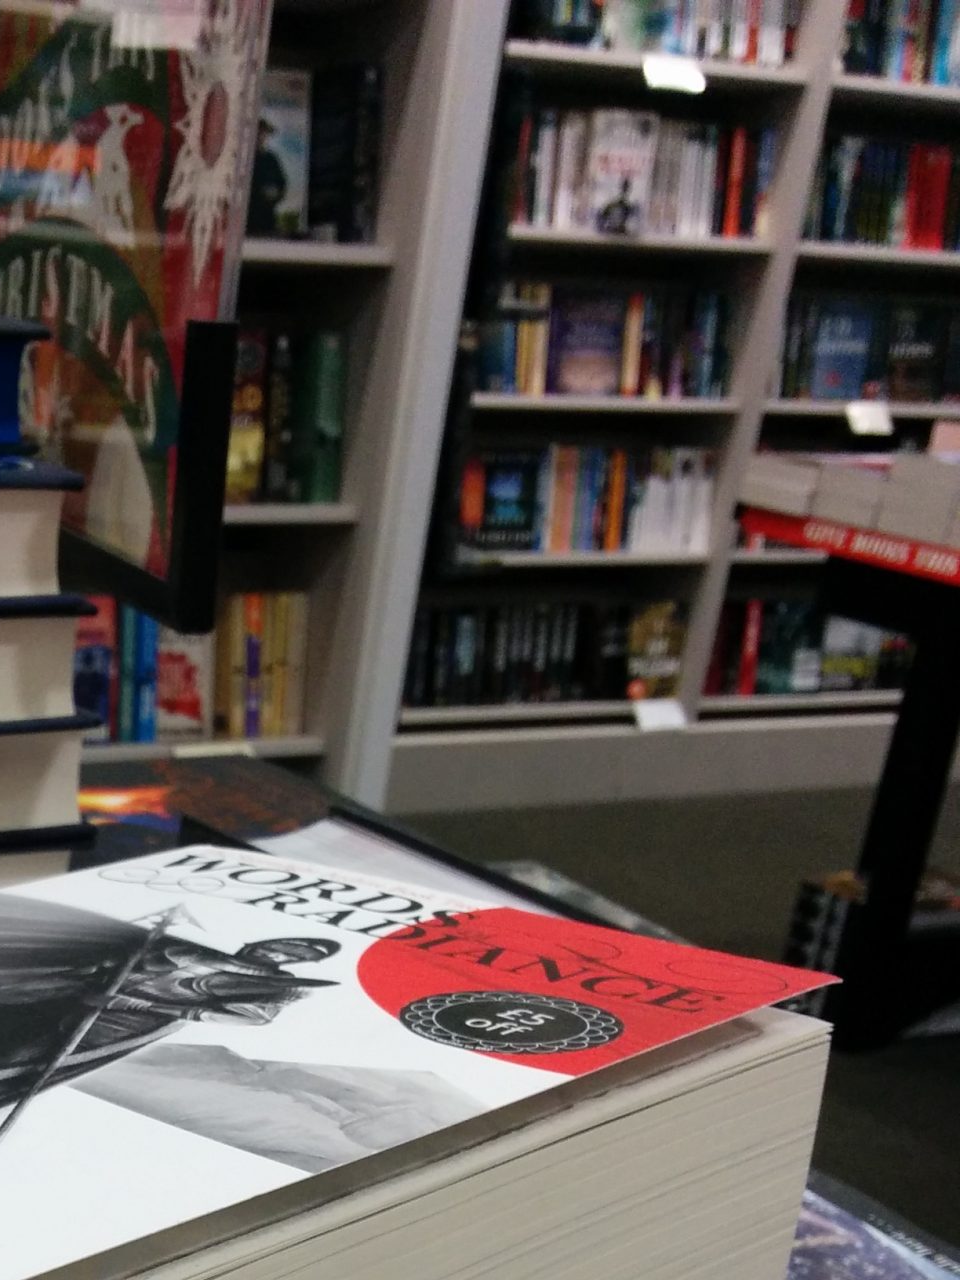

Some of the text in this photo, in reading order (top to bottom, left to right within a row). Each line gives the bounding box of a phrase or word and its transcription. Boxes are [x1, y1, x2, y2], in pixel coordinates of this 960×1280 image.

[163, 855, 476, 928] WORDS
[236, 892, 726, 1014] RADIANCE
[465, 1017, 534, 1036] off
[496, 1008, 555, 1026] £5
